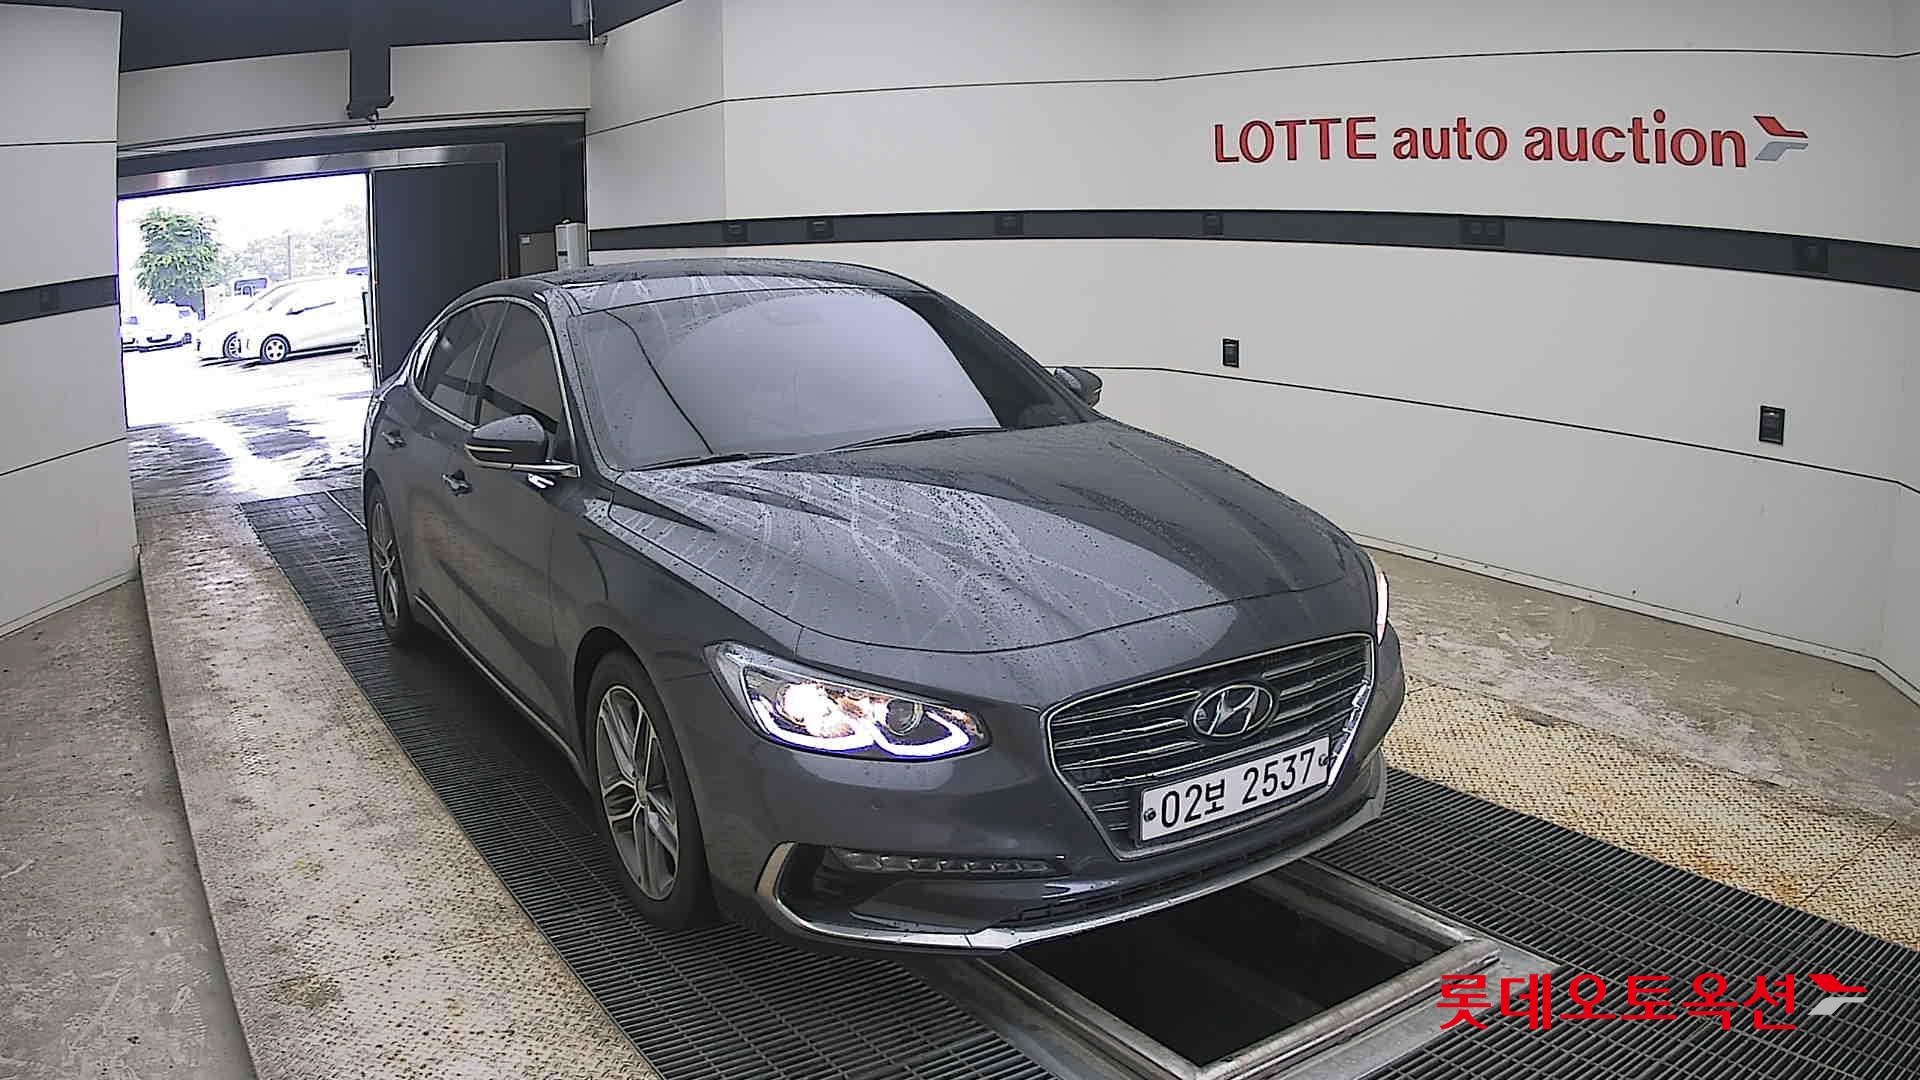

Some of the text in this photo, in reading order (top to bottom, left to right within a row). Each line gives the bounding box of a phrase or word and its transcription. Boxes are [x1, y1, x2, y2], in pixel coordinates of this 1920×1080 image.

[1214, 109, 1748, 168] LOTTE auto auction
[1161, 746, 1316, 828] 02보 2537
